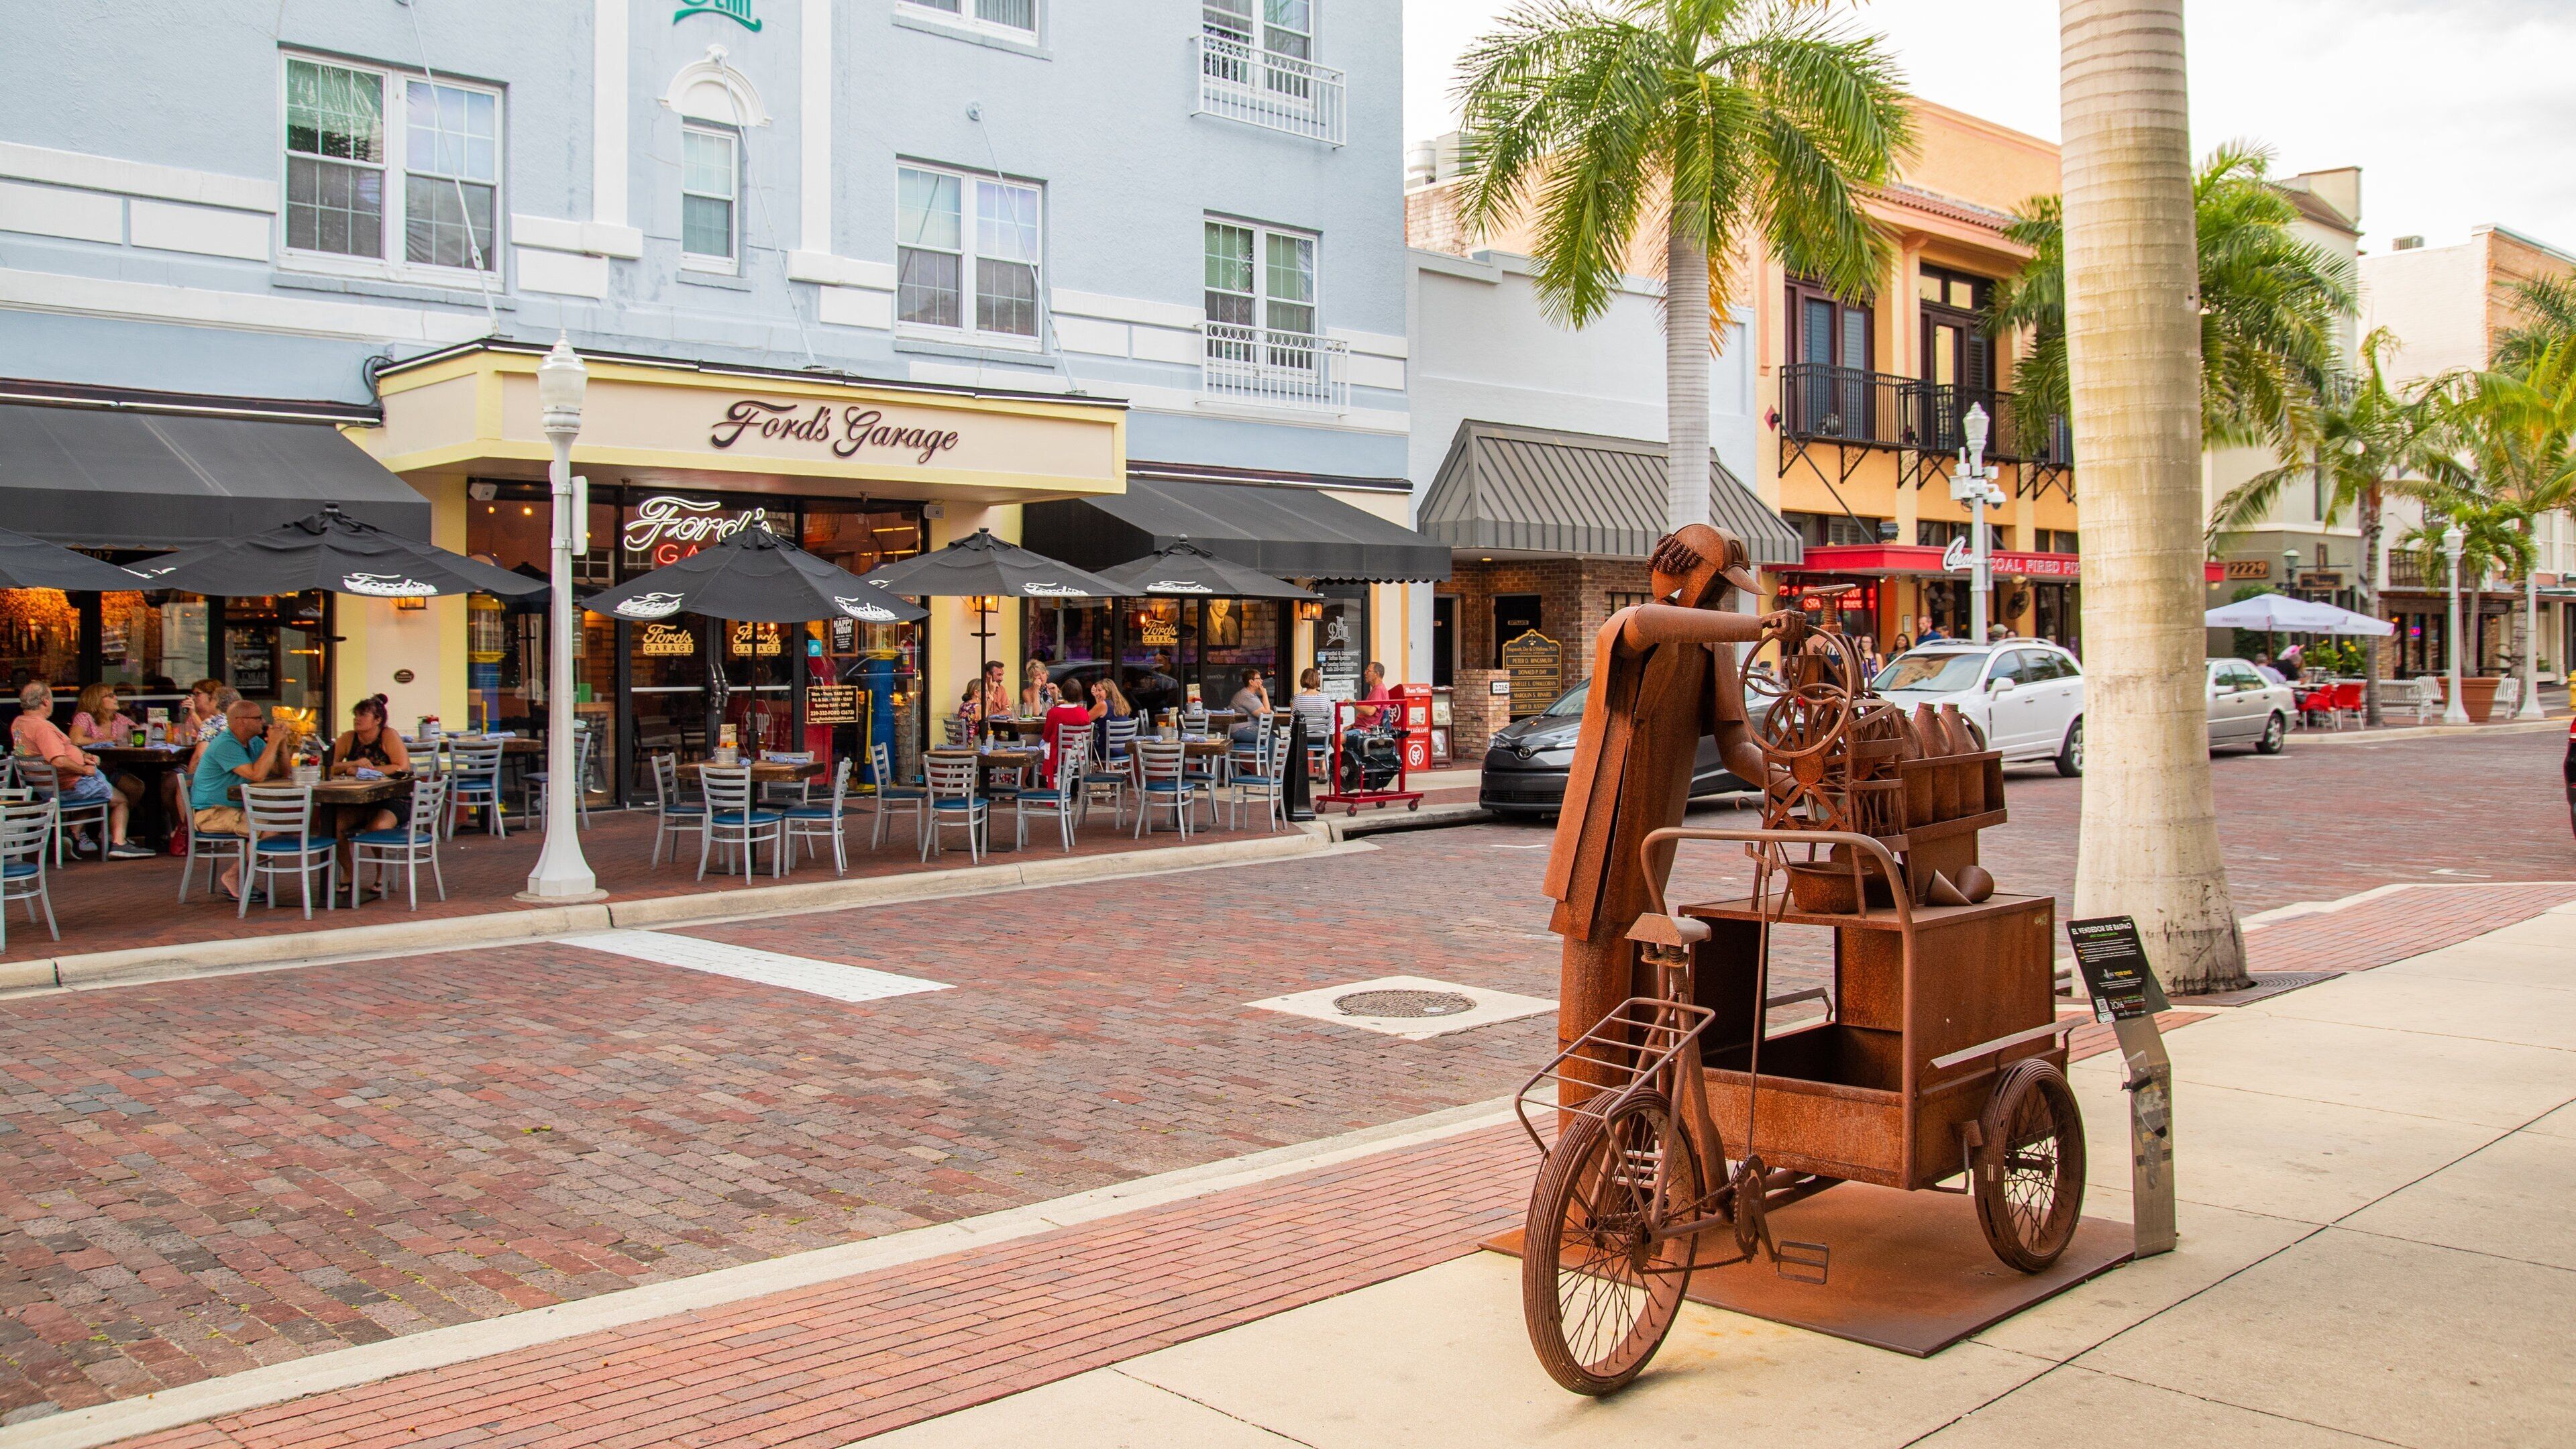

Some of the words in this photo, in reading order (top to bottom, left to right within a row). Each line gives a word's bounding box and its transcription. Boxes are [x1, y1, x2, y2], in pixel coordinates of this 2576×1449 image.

[710, 400, 831, 449] Ford's
[832, 406, 959, 465] Garage
[1990, 557, 2023, 572] COAL
[2026, 560, 2060, 573] FIRED
[2063, 561, 2080, 574] PIZ
[2231, 561, 2266, 575] 2229
[834, 619, 853, 628] HAPPY
[836, 626, 851, 634] HOUR
[1142, 619, 1177, 636] Fords
[643, 625, 694, 644] Fords
[645, 644, 693, 653] GARAGE
[734, 644, 780, 653] GAAGE
[745, 711, 770, 734] SOP
[2078, 925, 2106, 934] VENDEDOR
